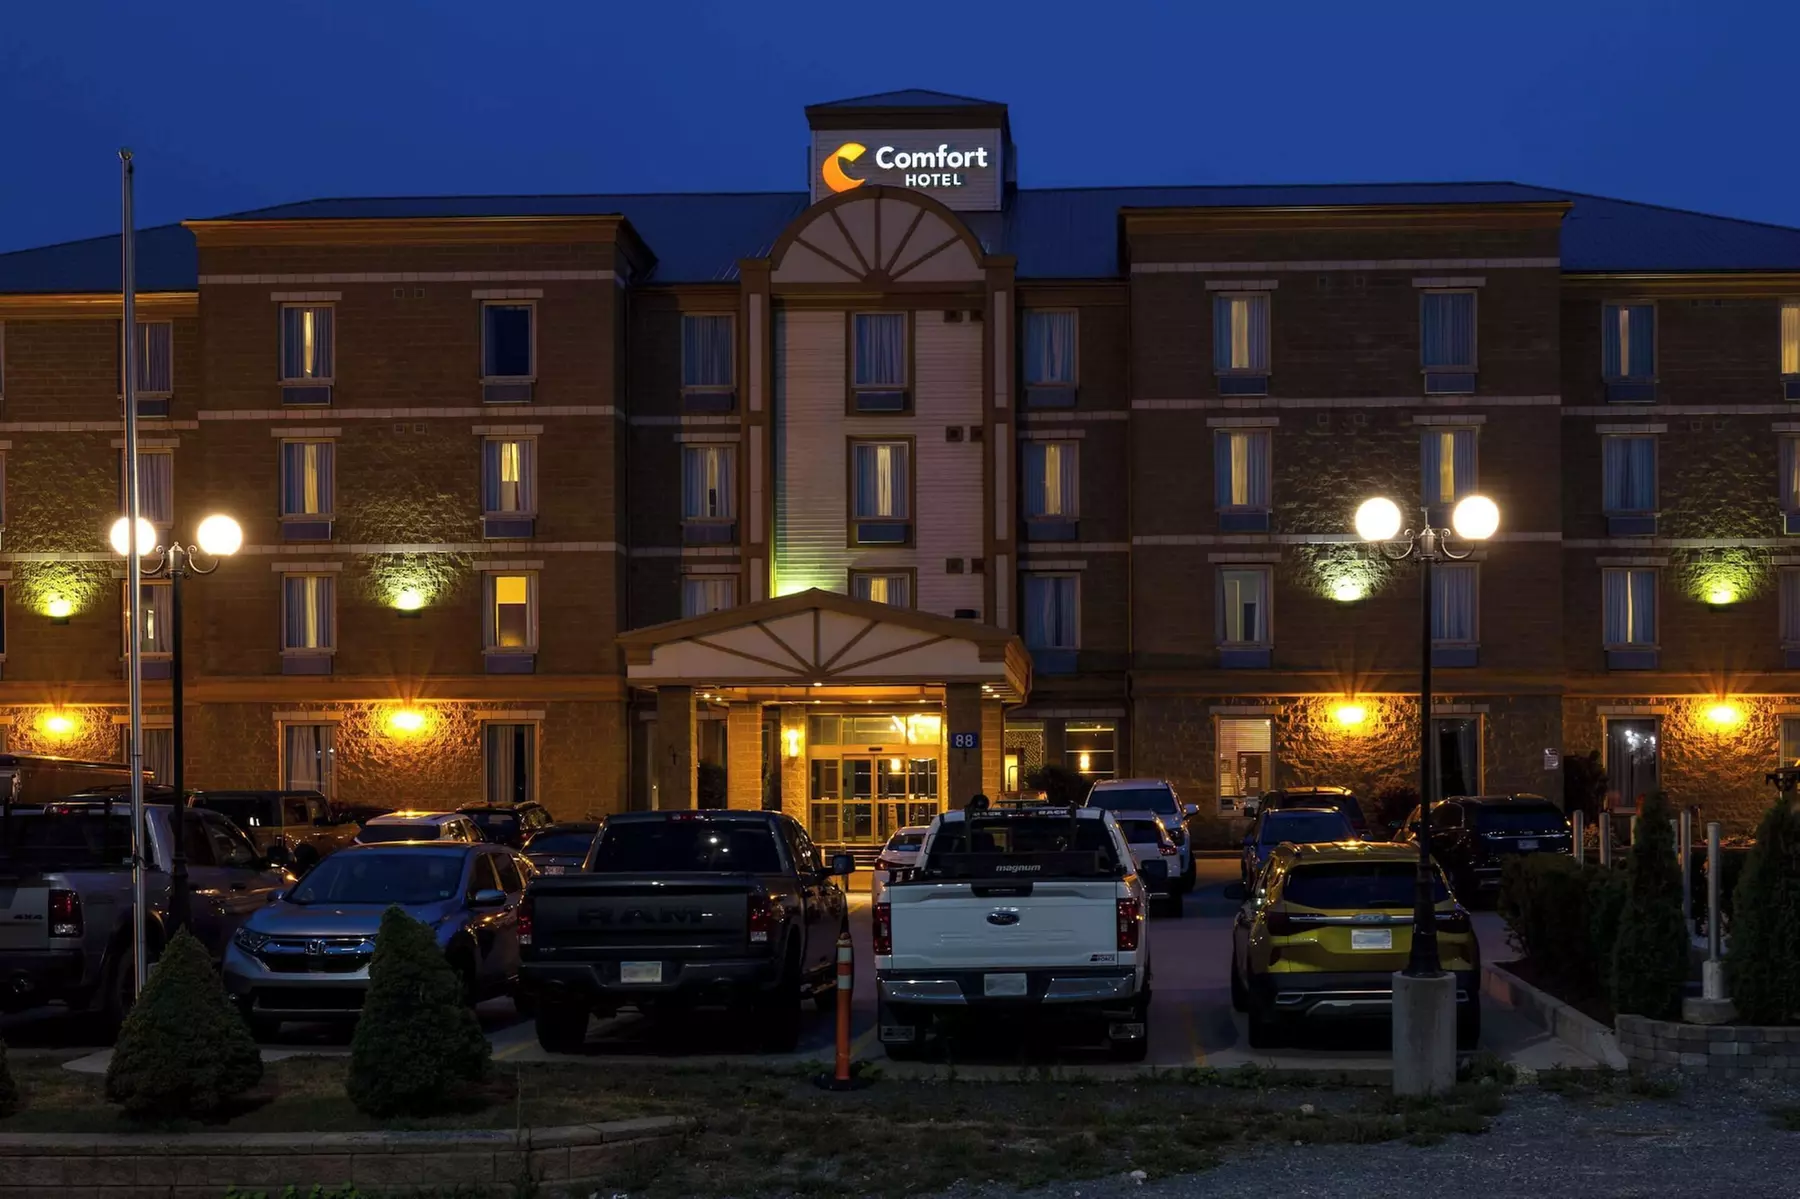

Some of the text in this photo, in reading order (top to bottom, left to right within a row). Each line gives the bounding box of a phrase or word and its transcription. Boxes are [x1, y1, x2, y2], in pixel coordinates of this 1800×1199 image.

[875, 143, 988, 170] Comfort
[904, 173, 962, 187] HOTEL
[955, 734, 974, 748] 88
[995, 863, 1042, 874] magnum
[577, 905, 703, 926] RAM
